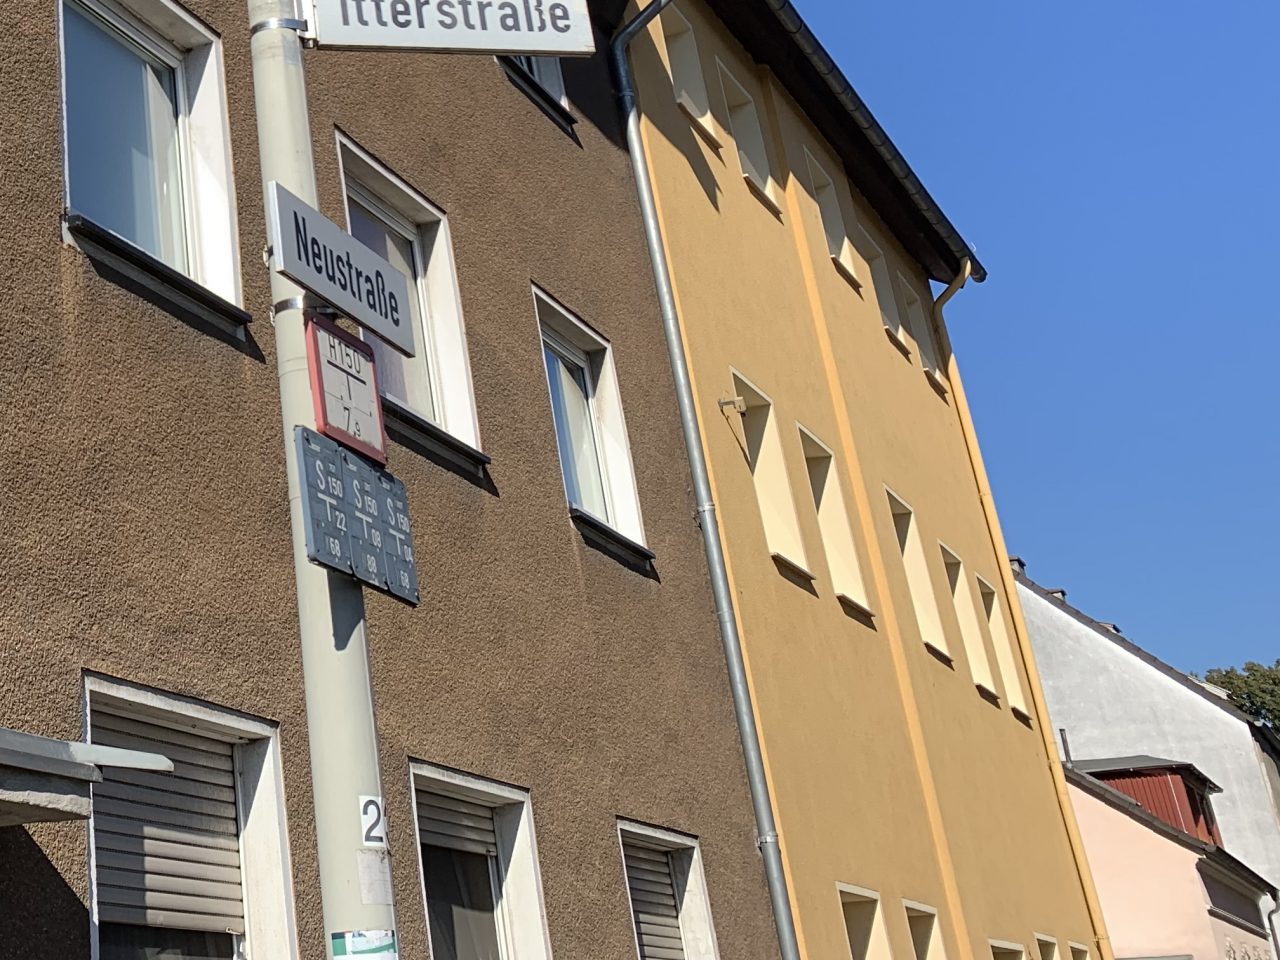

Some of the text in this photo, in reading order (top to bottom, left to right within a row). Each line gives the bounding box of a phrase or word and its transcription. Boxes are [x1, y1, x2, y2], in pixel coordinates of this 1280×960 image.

[293, 210, 400, 327] Neustraße
[315, 459, 343, 498] S 150
[353, 479, 378, 516] S 150
[386, 498, 395, 526] S
